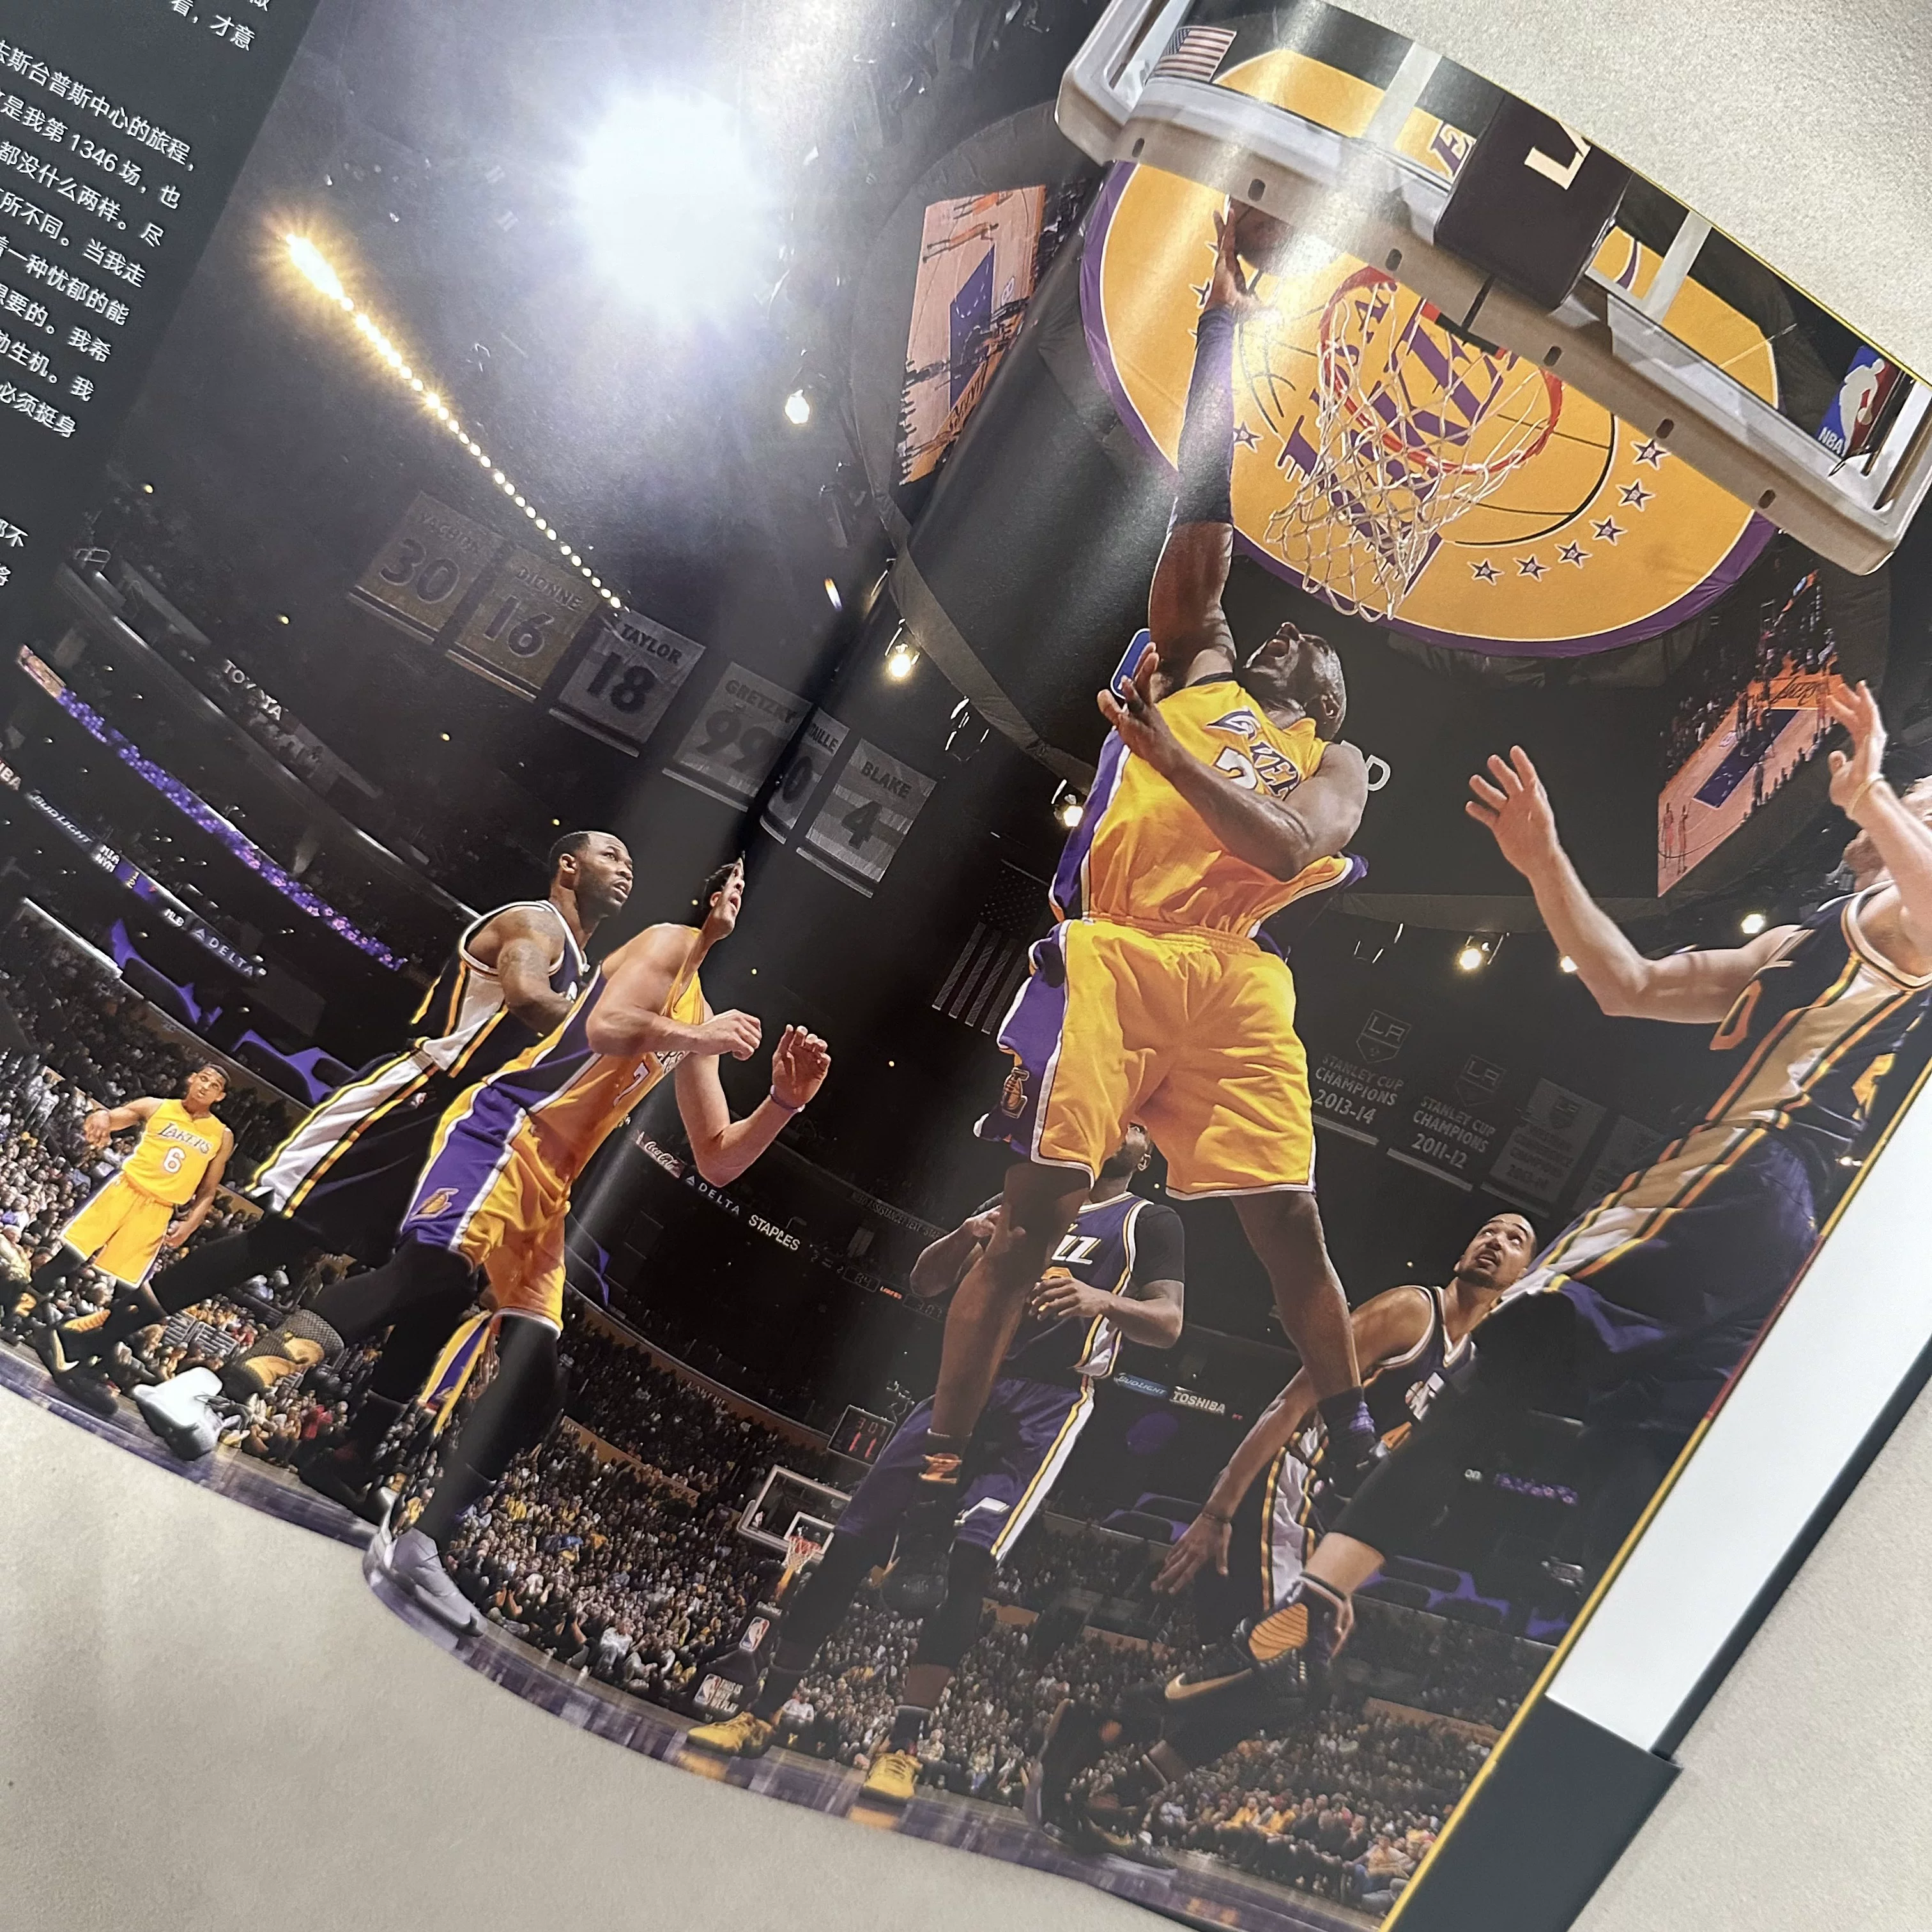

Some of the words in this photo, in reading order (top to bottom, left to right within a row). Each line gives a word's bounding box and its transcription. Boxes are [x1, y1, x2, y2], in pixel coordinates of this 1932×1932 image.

[0, 88, 68, 142] 是我第
[71, 134, 118, 172] 1346
[0, 188, 146, 288] 所不同。当我走
[1818, 427, 1844, 454] NBA
[378, 539, 460, 604] 30
[483, 595, 555, 657] 16
[621, 624, 682, 664] TAYLOR
[588, 651, 658, 714] 18
[725, 680, 798, 723] GRETZKY
[861, 760, 912, 799] BLAKE
[841, 801, 882, 850] 4
[209, 937, 254, 977] DELTA
[1315, 1067, 1397, 1106] CHAMPIONS
[1322, 1054, 1377, 1083] STANLEY
[1377, 1076, 1404, 1091] CUP
[1313, 1089, 1376, 1124] 2013-14
[1420, 1096, 1472, 1126] STANLEY
[1472, 1119, 1496, 1137] CUP
[1411, 1133, 1468, 1169] 2011-12
[1413, 1110, 1489, 1153] CHAMPIONS
[164, 1146, 186, 1174] 6
[699, 1183, 740, 1215] DELTA
[749, 1215, 801, 1250] STAPLES
[1173, 1391, 1226, 1414] TOSHIBA
